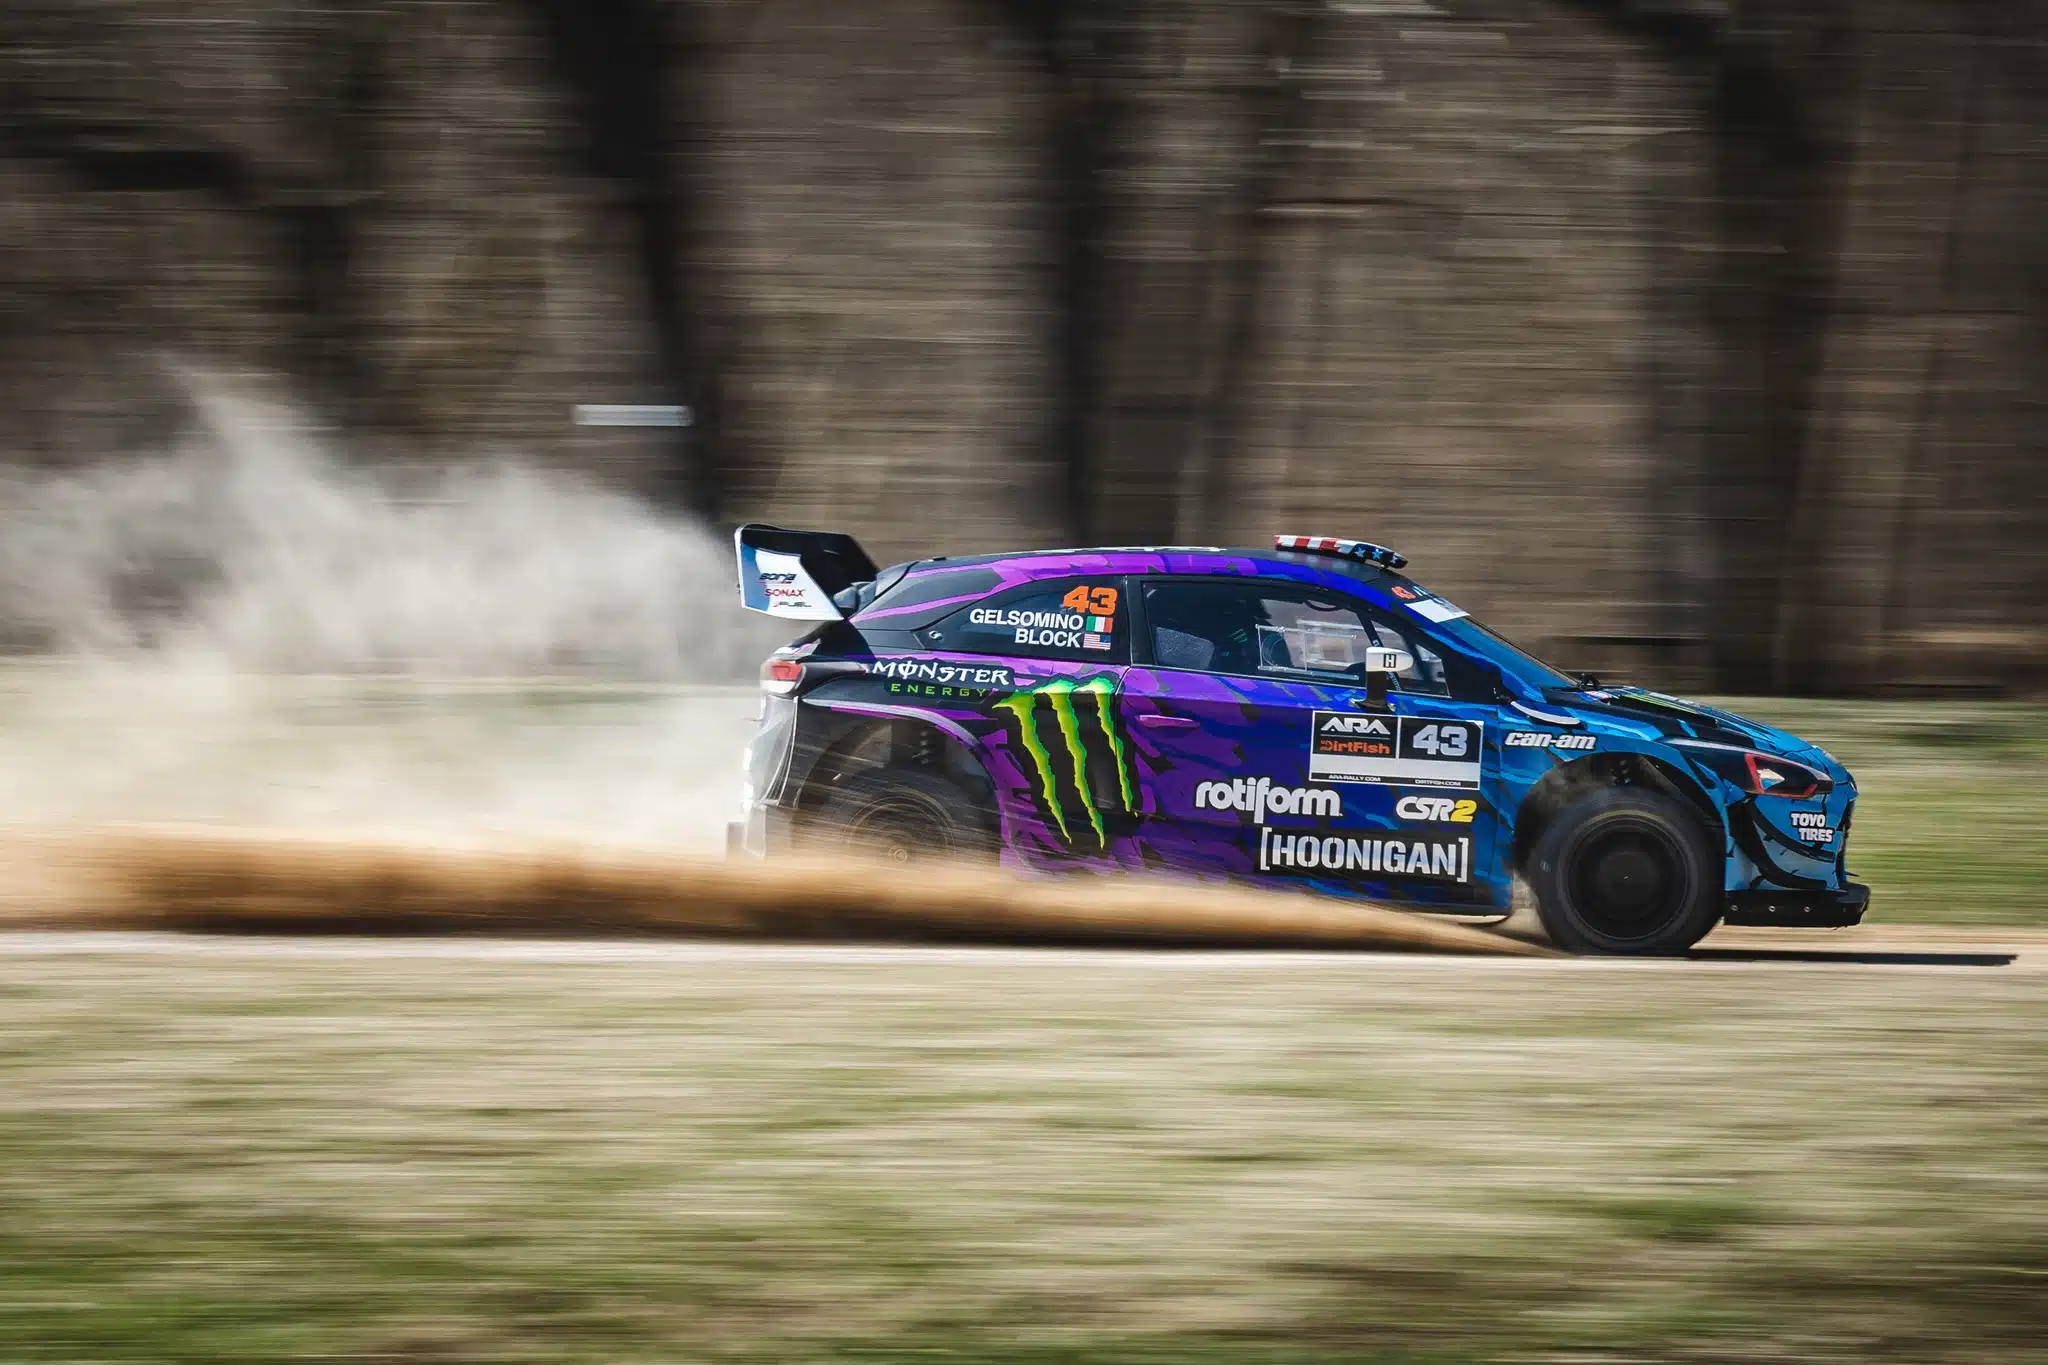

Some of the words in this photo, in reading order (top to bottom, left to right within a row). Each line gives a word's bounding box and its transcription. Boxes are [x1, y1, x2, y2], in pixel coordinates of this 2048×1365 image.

[764, 588, 805, 597] SONAX
[1063, 585, 1118, 615] 43
[970, 608, 1083, 630] GELSOMINO
[1015, 628, 1082, 648] BLOCK
[890, 683, 986, 697] ENERGY
[1321, 716, 1391, 735] ARA
[1320, 740, 1390, 754] DirtFish
[1413, 724, 1468, 757] 43
[1504, 732, 1597, 749] can-am
[1395, 796, 1477, 822] CSR2
[1790, 813, 1826, 827] TOYO
[1798, 828, 1833, 842] TIRES
